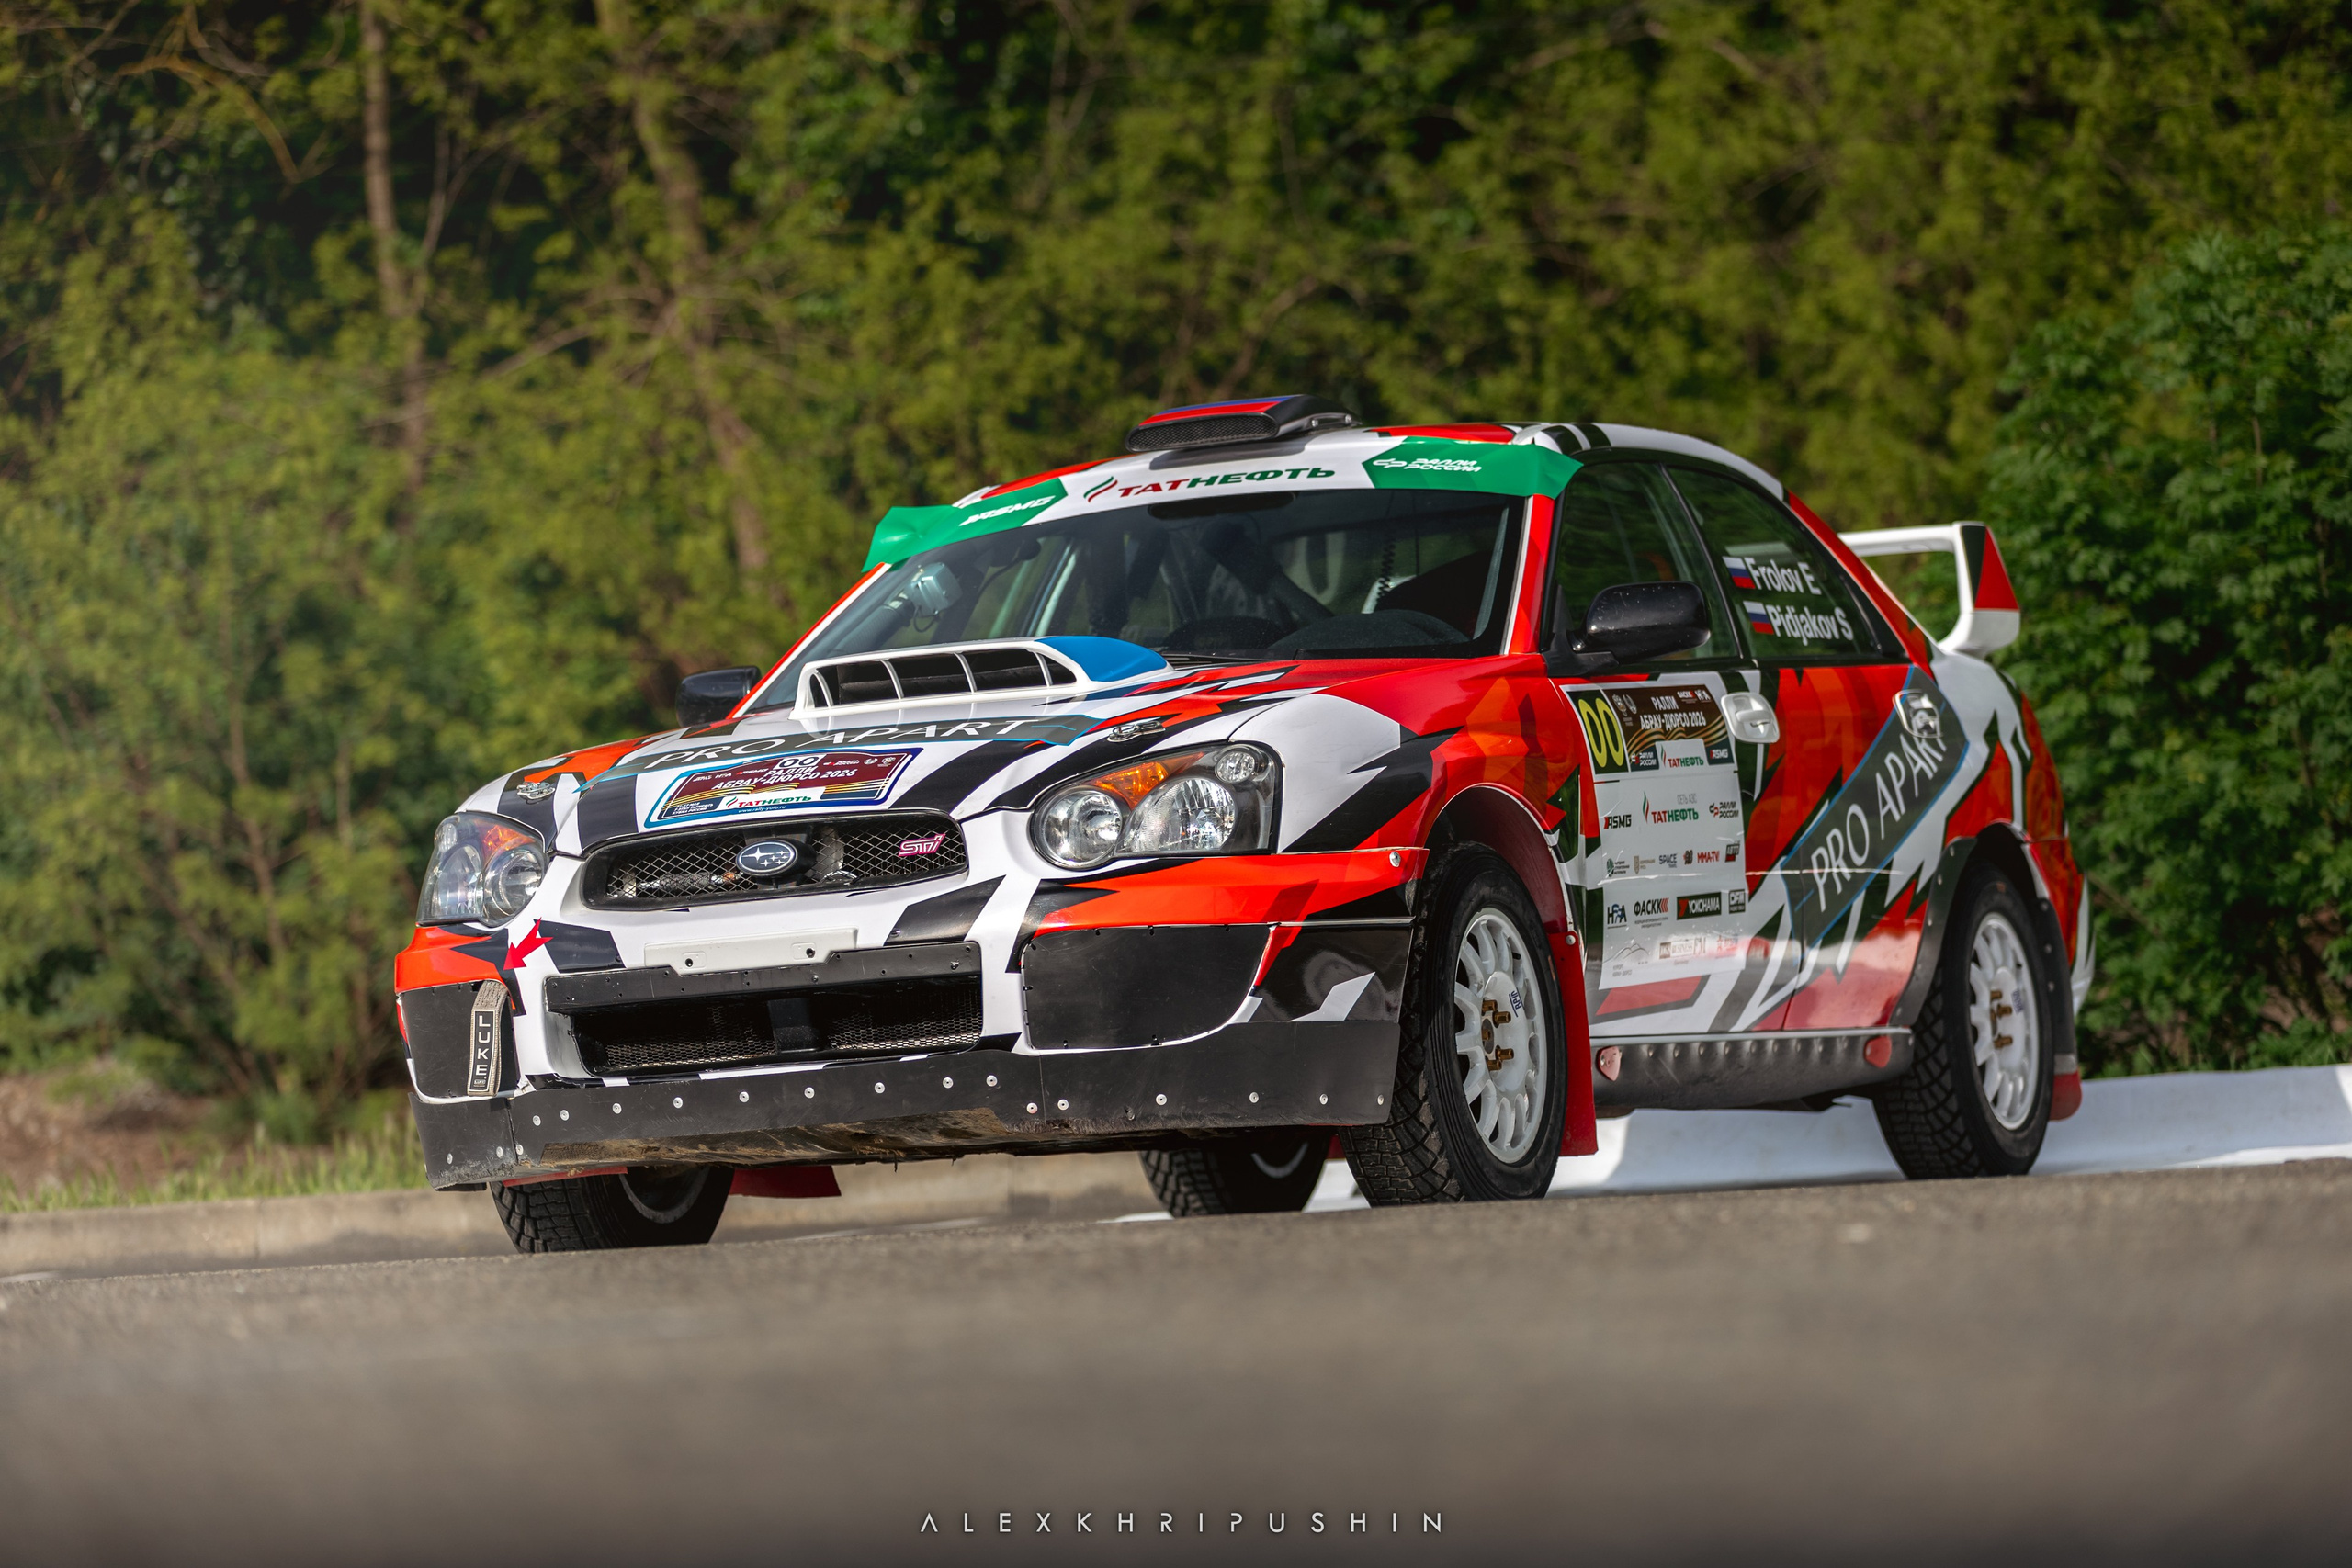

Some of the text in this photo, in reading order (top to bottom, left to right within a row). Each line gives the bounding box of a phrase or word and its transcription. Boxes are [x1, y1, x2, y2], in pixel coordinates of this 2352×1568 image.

[1118, 468, 1336, 498] ТАТНЕФТЬ
[1744, 557, 1822, 595] Frolov E
[1765, 604, 1854, 647] Pidjakov S
[1650, 696, 1679, 711] РАЛЛИ
[1640, 712, 1690, 731] АБРАУ-ДЮРСО
[1689, 711, 1707, 727] 2026
[1577, 697, 1625, 768] 00
[644, 719, 1038, 769] PRO APART
[778, 756, 820, 768] 00
[1668, 756, 1704, 768] ТАТНЕФТЬ
[711, 772, 819, 790] АБРАУ-ДЮРСО
[820, 768, 858, 779] 2026
[764, 765, 819, 777] РАЛЛИ
[738, 795, 812, 807] ТАТНЕФТЬ
[1651, 807, 1699, 824] ТАТНЕФТЬ
[1719, 809, 1739, 818] РОССИИ
[1658, 853, 1678, 865] SPACE
[1811, 803, 1870, 913] PRO
[1634, 899, 1663, 917] ФАСКК
[1689, 897, 1720, 914] YOKOHAMA
